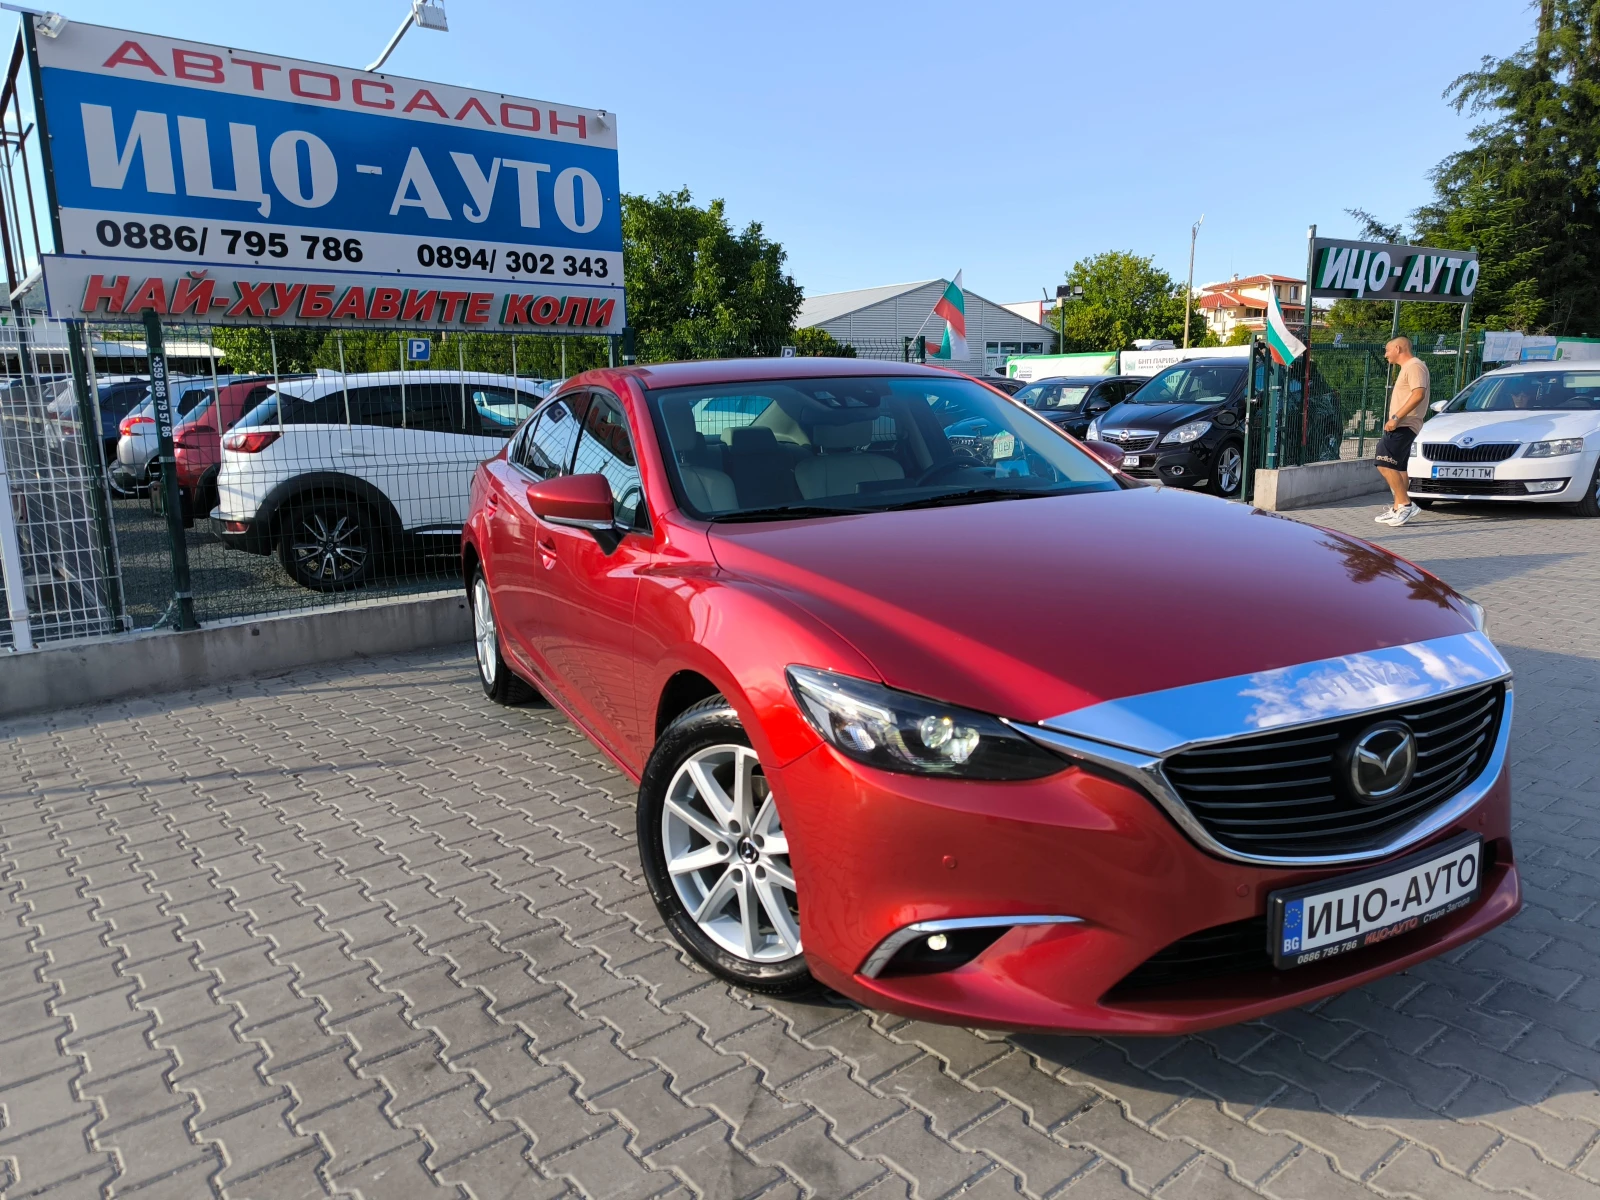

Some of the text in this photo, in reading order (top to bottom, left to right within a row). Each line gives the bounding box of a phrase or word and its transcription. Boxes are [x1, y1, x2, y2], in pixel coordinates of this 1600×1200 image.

[102, 40, 588, 139] АВТОСАЛОН
[96, 220, 363, 262] 0886/ 795 786
[416, 244, 608, 278] 0894/ 302 343
[1318, 247, 1480, 298] ИЦО-АУТО
[80, 269, 616, 327] НАЙ-ХУБАВИТЕ КОЛИ
[412, 341, 426, 358] P
[152, 356, 172, 437] +359 886 79 57 86
[1452, 468, 1475, 478] 4711
[1307, 854, 1476, 939] ИЦО-АУТО
[1423, 896, 1471, 924] Стара Загора
[1283, 937, 1300, 953] BG
[1364, 917, 1419, 945] ИЦО-АУТО
[1297, 940, 1357, 965] 0886 795 786
